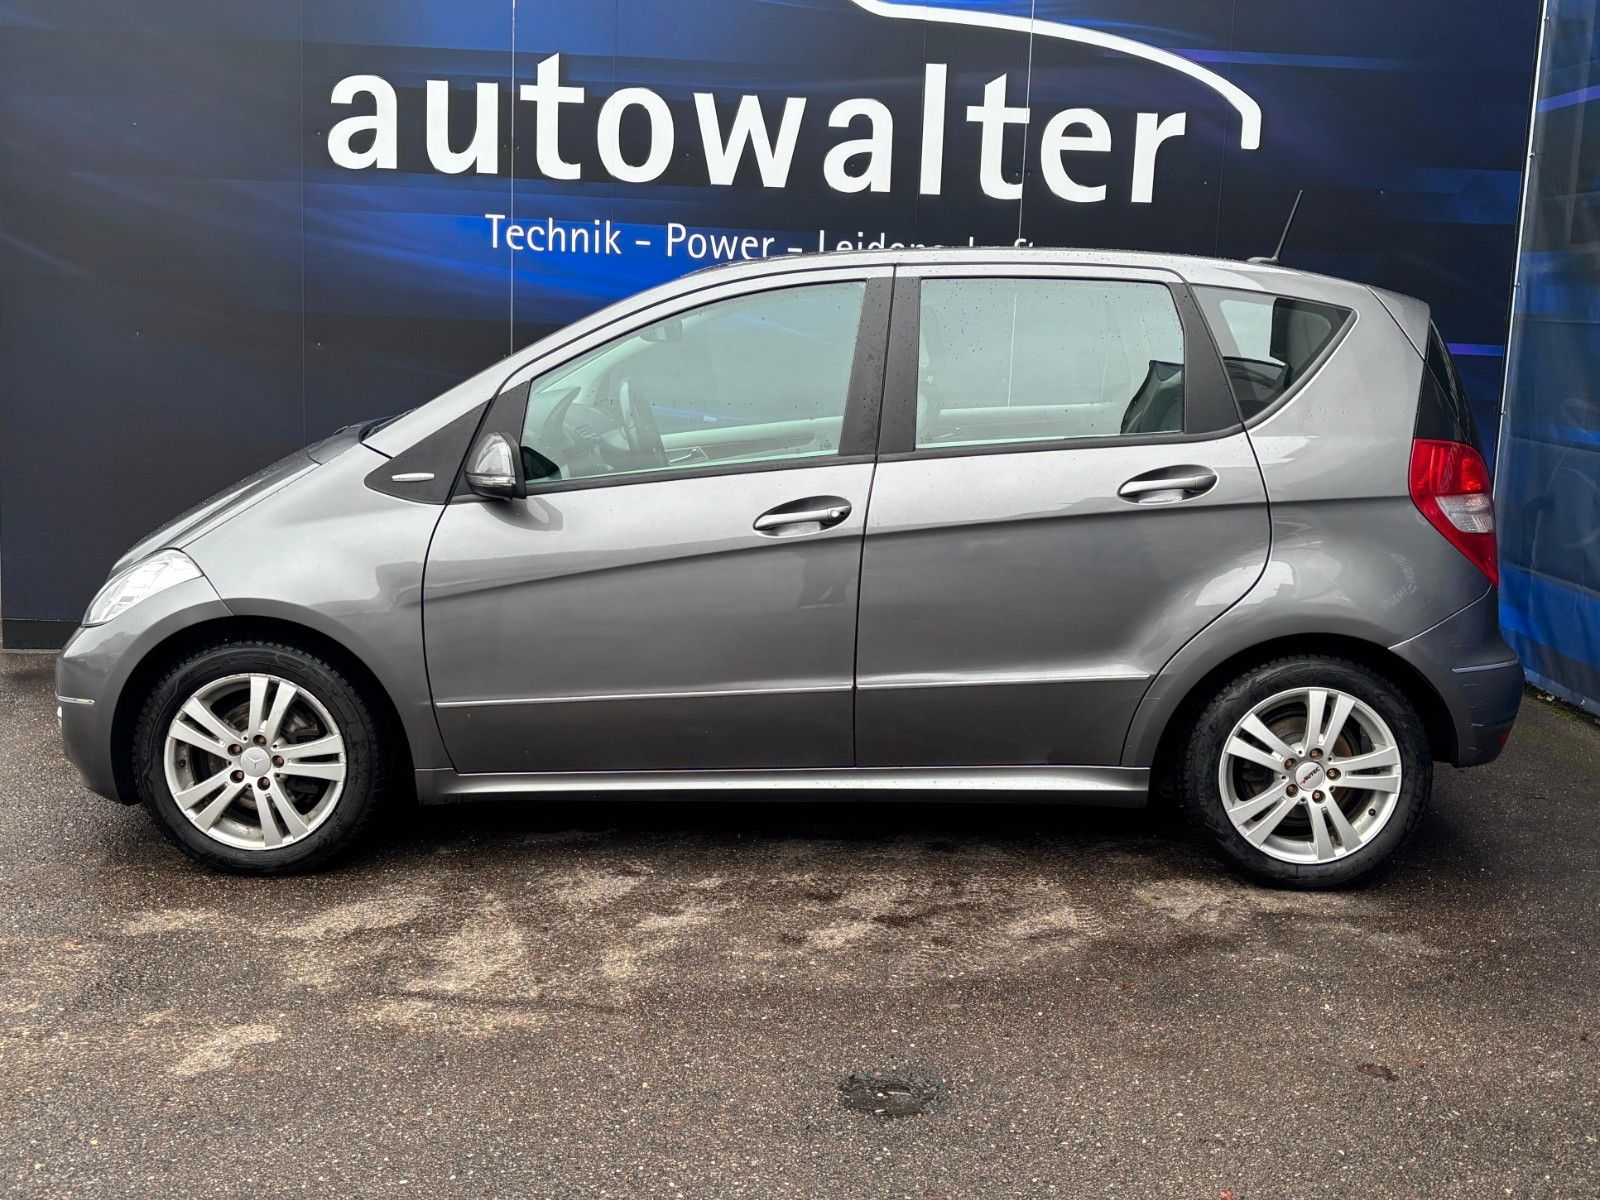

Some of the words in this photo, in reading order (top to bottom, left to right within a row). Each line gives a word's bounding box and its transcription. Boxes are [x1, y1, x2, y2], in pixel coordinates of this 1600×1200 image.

[327, 52, 1187, 205] autowalter
[484, 213, 622, 255] Technik
[667, 222, 775, 260] Power
